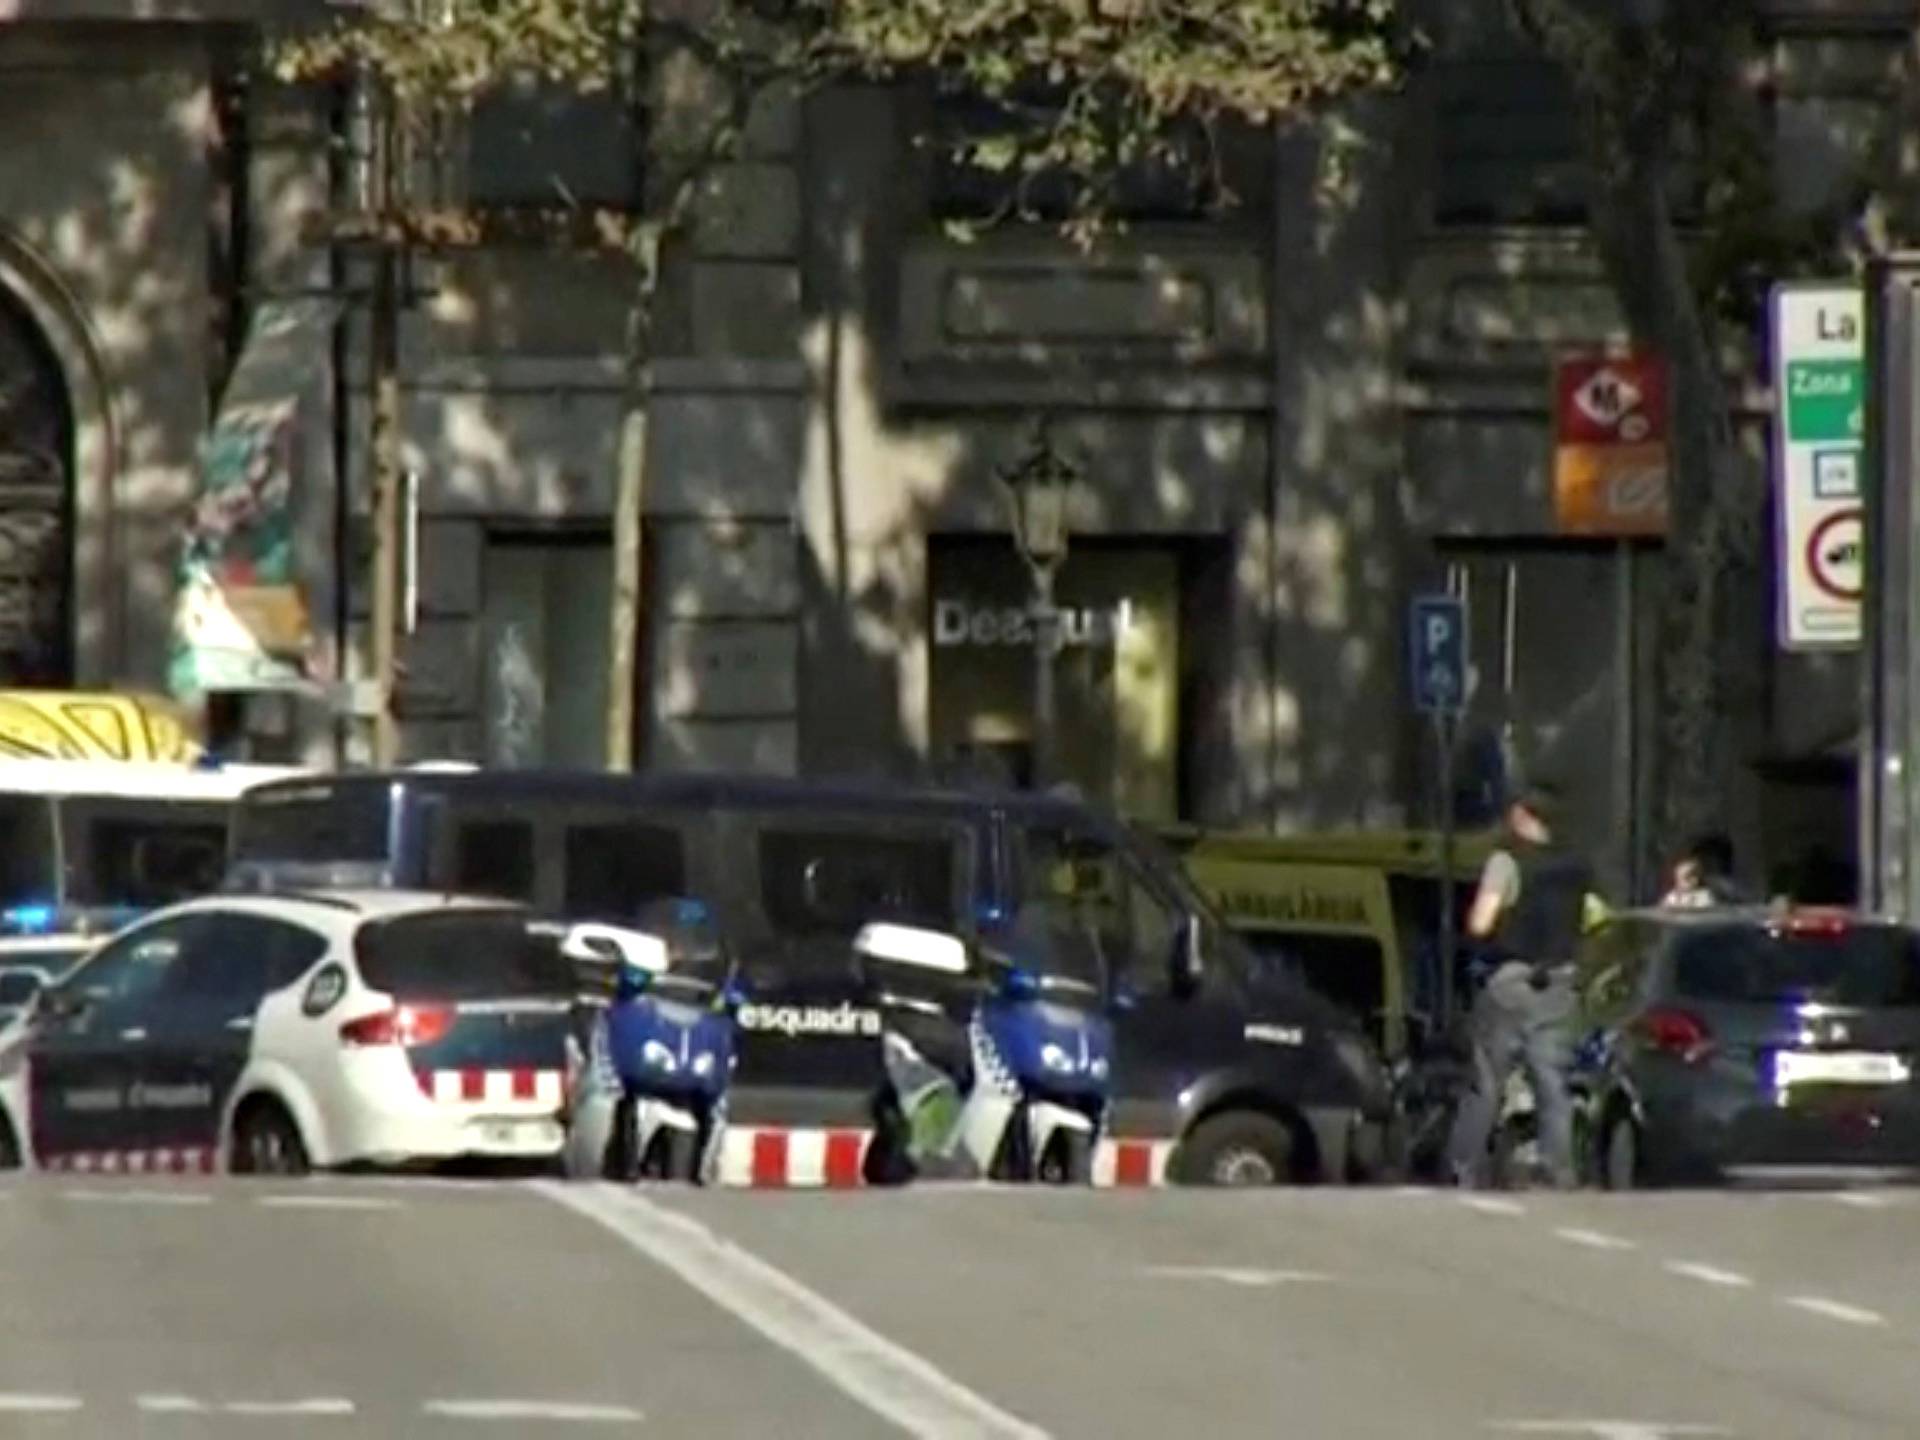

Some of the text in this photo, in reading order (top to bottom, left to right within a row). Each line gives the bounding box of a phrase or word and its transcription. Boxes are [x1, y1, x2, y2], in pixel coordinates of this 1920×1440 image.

[1818, 309, 1856, 342] La
[934, 597, 1132, 652] Desgul
[1427, 614, 1450, 654] P
[737, 1000, 881, 1037] esquadra
